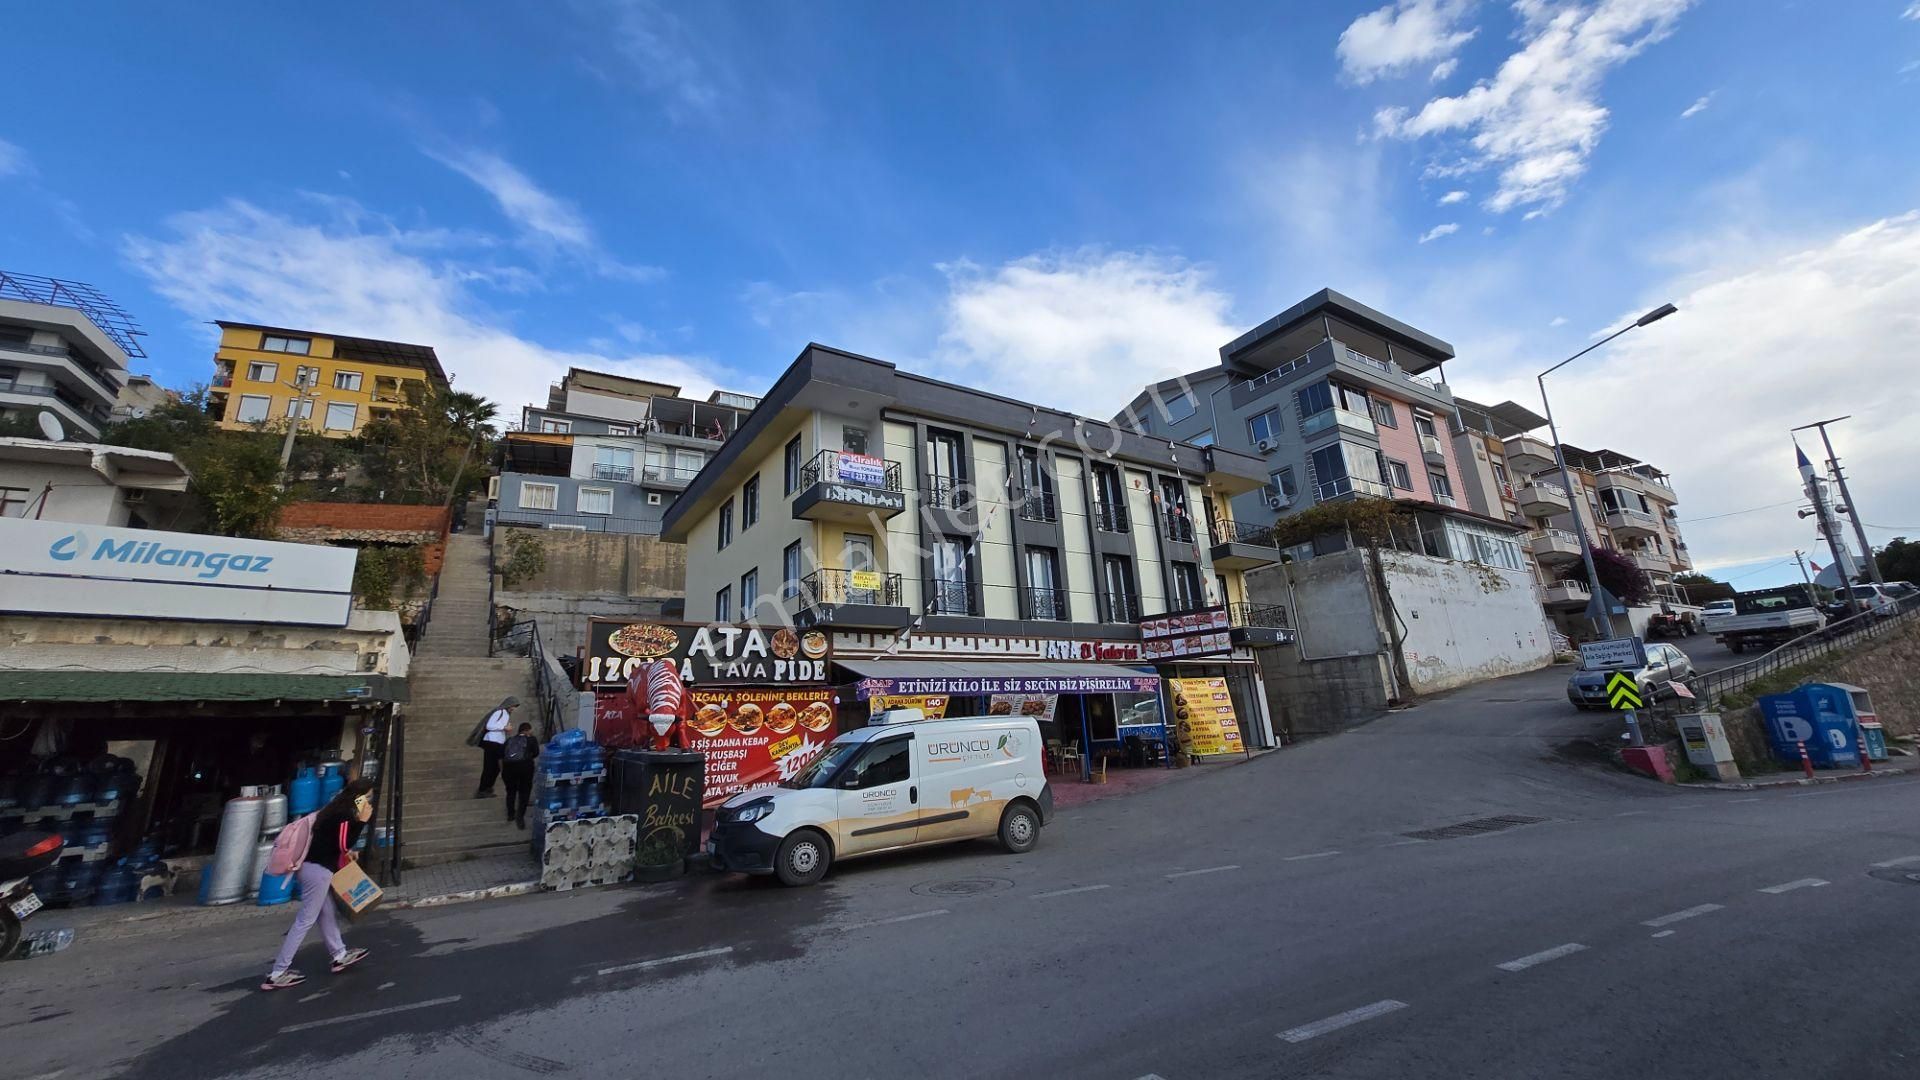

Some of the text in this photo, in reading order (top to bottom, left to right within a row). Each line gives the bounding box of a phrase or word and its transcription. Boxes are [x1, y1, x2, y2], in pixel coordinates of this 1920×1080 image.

[91, 538, 274, 578] Milangaz
[688, 626, 767, 658] ATA
[1046, 640, 1080, 660] ATA
[588, 656, 826, 681] IZGA TAVA PİDE
[898, 678, 1131, 693] ETİNİZİ KİLO İLE SİZ SEÇİN BİZ PİŞİRELİM
[692, 691, 829, 704] IZGARA ŞÖLENİNE BEKLERİZ
[691, 737, 769, 750] 3 ŞİŞ ADANA KEBAP
[711, 749, 748, 761] KUŞBAŞI
[711, 761, 737, 772] CİĞER
[648, 768, 696, 799] AİLE
[711, 773, 739, 784] TAVUK
